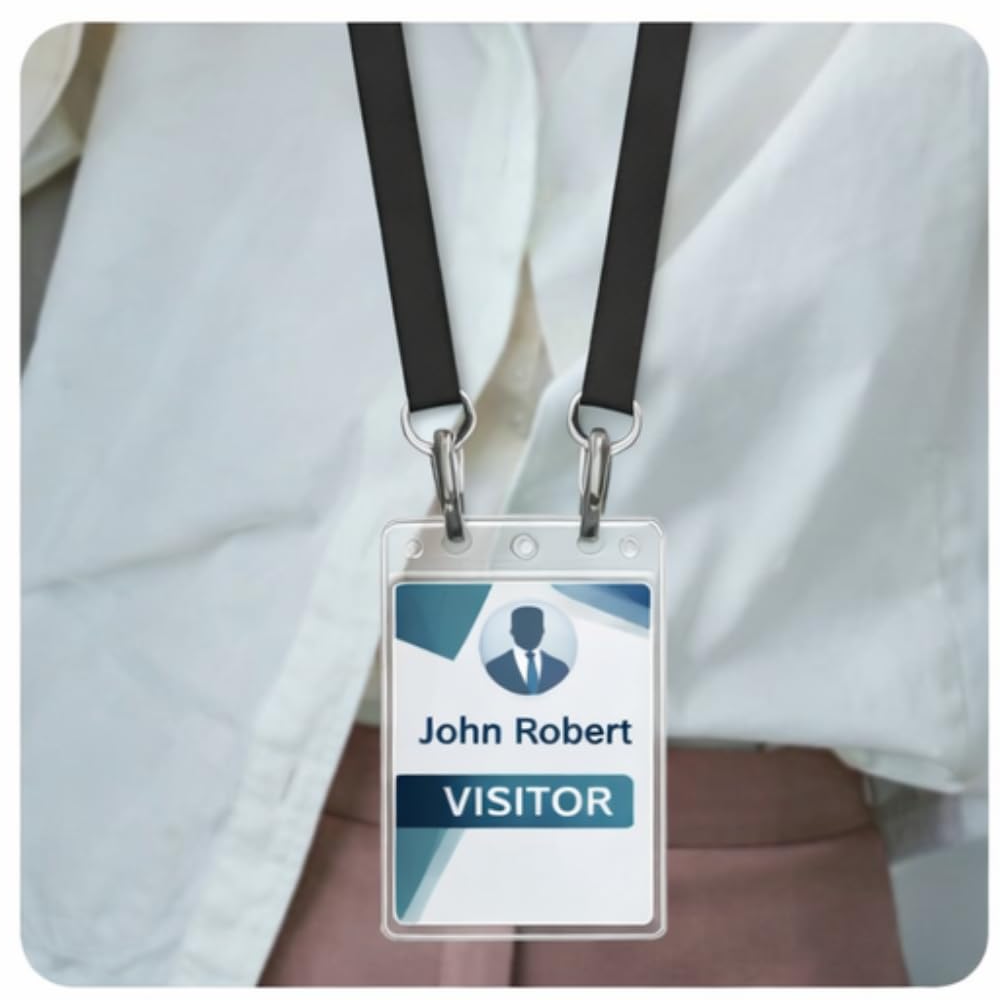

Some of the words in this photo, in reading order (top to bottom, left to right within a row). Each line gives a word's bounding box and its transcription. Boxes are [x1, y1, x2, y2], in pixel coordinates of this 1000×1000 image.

[419, 716, 501, 745] John
[515, 716, 633, 745] Robert
[443, 786, 613, 818] VISITOR
